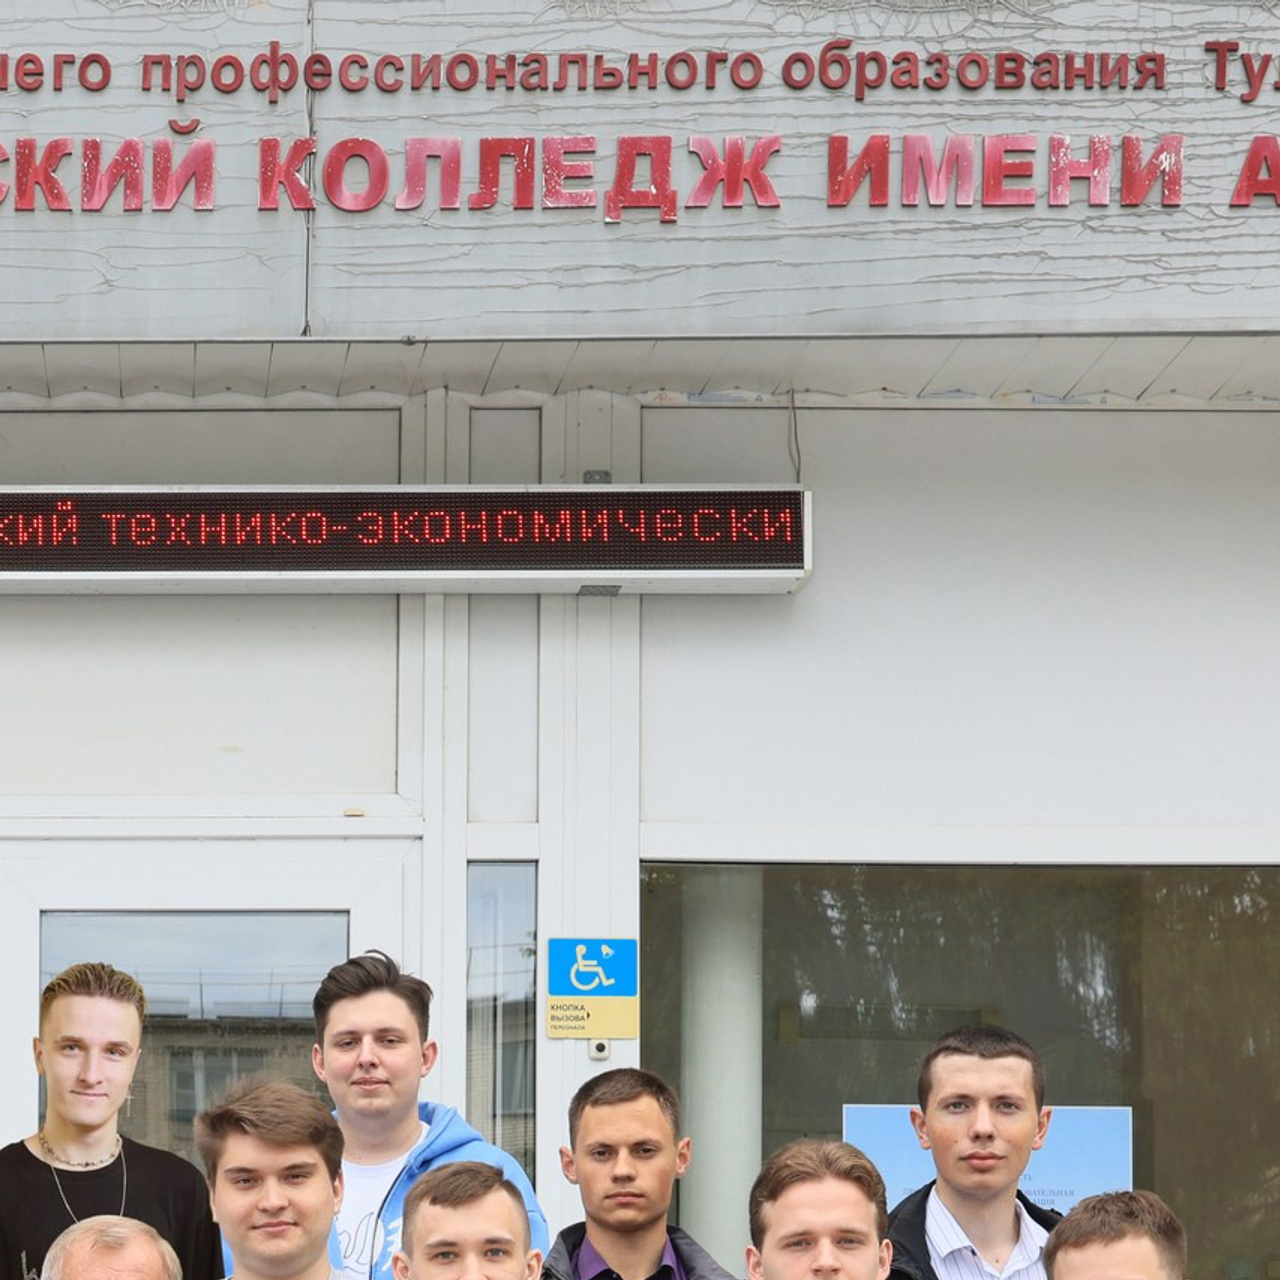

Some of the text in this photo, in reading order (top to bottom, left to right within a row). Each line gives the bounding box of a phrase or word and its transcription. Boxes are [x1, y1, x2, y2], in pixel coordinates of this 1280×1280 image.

[141, 40, 764, 104] профессионального
[782, 38, 1167, 102] образования
[1205, 40, 1280, 103] Ту
[258, 135, 783, 224] КОЛЛЕДЖ
[826, 133, 1184, 208] ИМЕНИ
[1229, 134, 1280, 208] А
[100, 507, 794, 549] технико-экономически
[550, 1004, 586, 1012] КНОПКА
[550, 1014, 586, 1022] ВЫЗОВА
